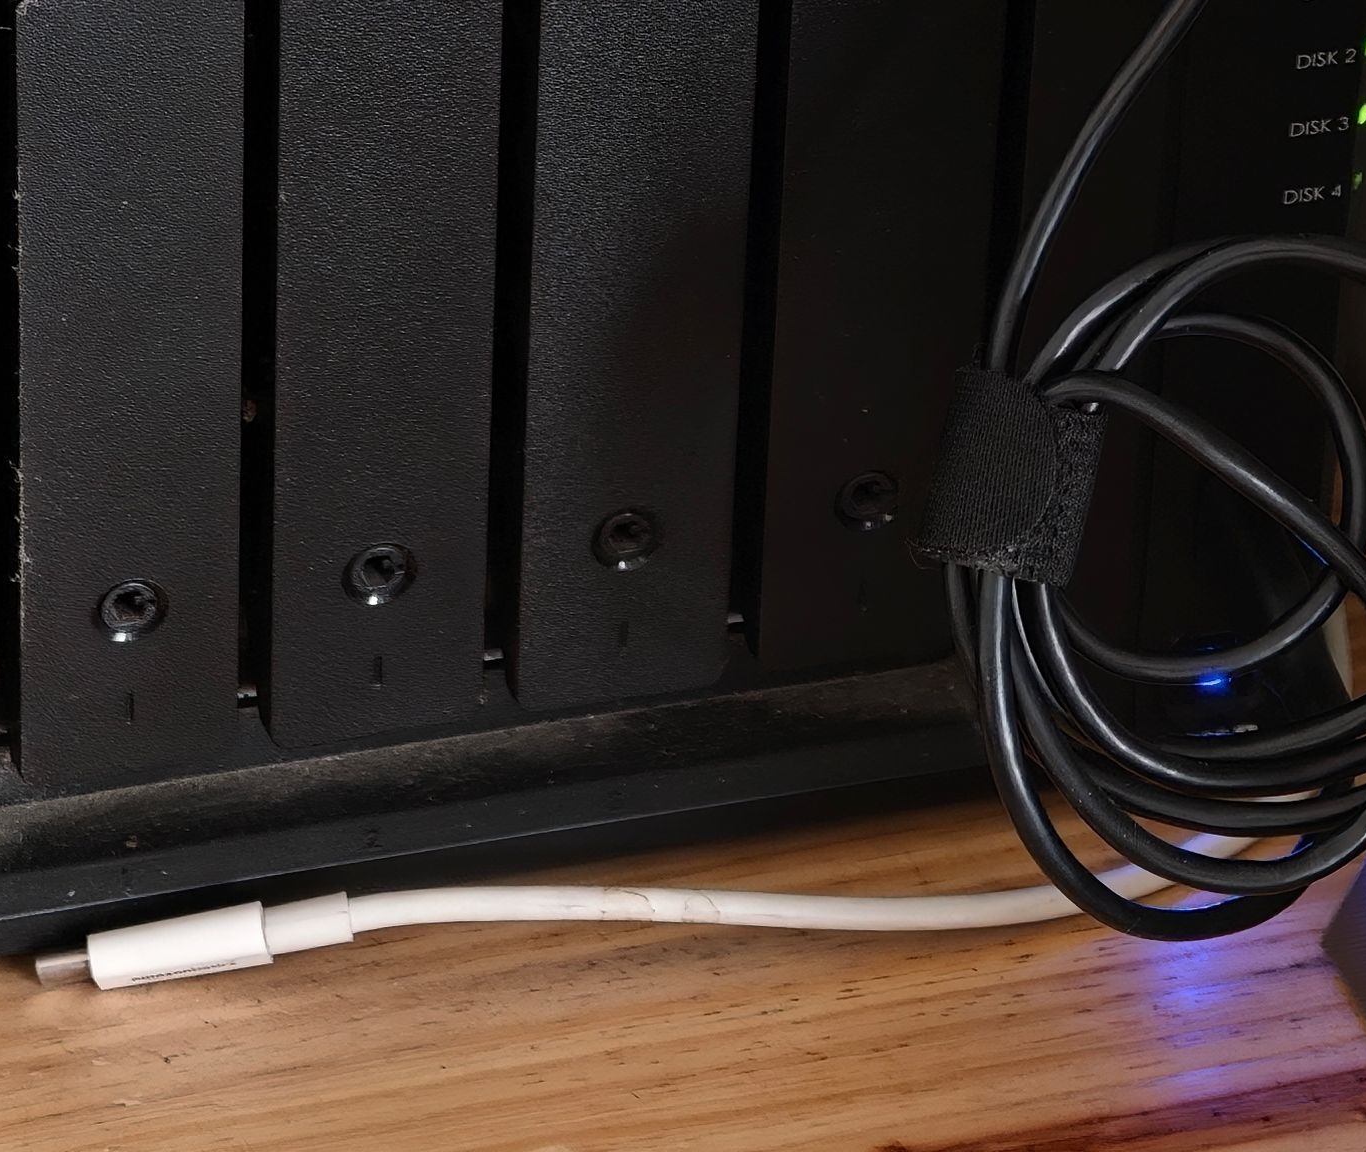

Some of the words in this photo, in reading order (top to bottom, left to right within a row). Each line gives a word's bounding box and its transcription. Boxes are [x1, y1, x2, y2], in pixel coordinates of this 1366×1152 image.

[1296, 50, 1338, 69] DISK
[1345, 48, 1356, 64] 2
[1289, 119, 1332, 137] DISK
[1338, 116, 1349, 132] 3
[1283, 185, 1326, 205] DISK
[1331, 184, 1342, 198] 4
